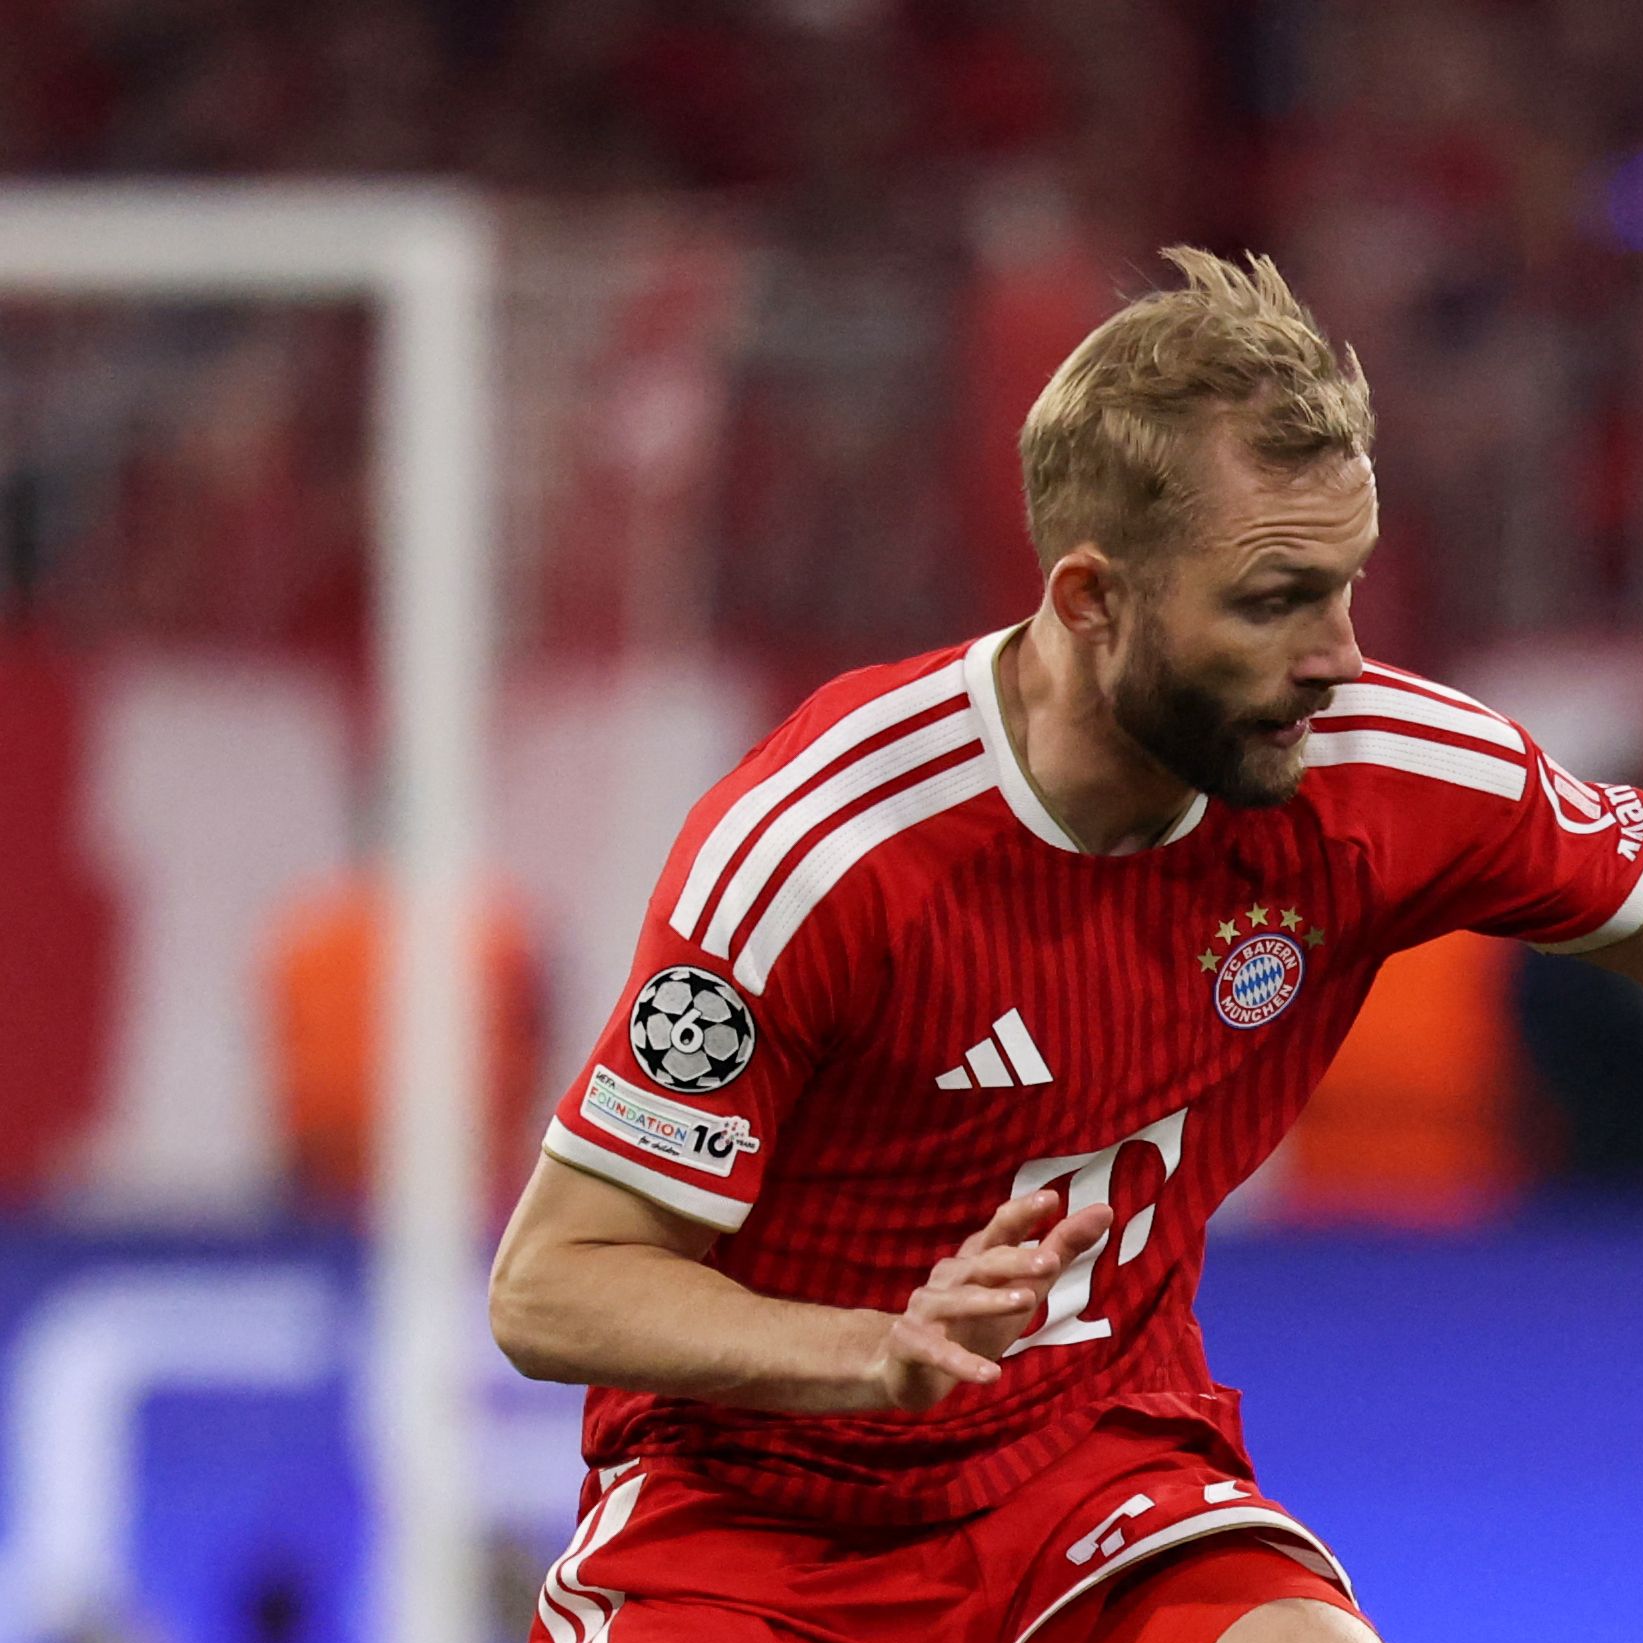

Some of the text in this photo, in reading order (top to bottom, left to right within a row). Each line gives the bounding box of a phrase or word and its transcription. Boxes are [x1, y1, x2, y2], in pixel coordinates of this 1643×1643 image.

[1223, 940, 1298, 981] FC BAYERN
[670, 1007, 704, 1054] 6
[588, 1087, 688, 1142] FOUNDATION
[693, 1124, 733, 1158] 10
